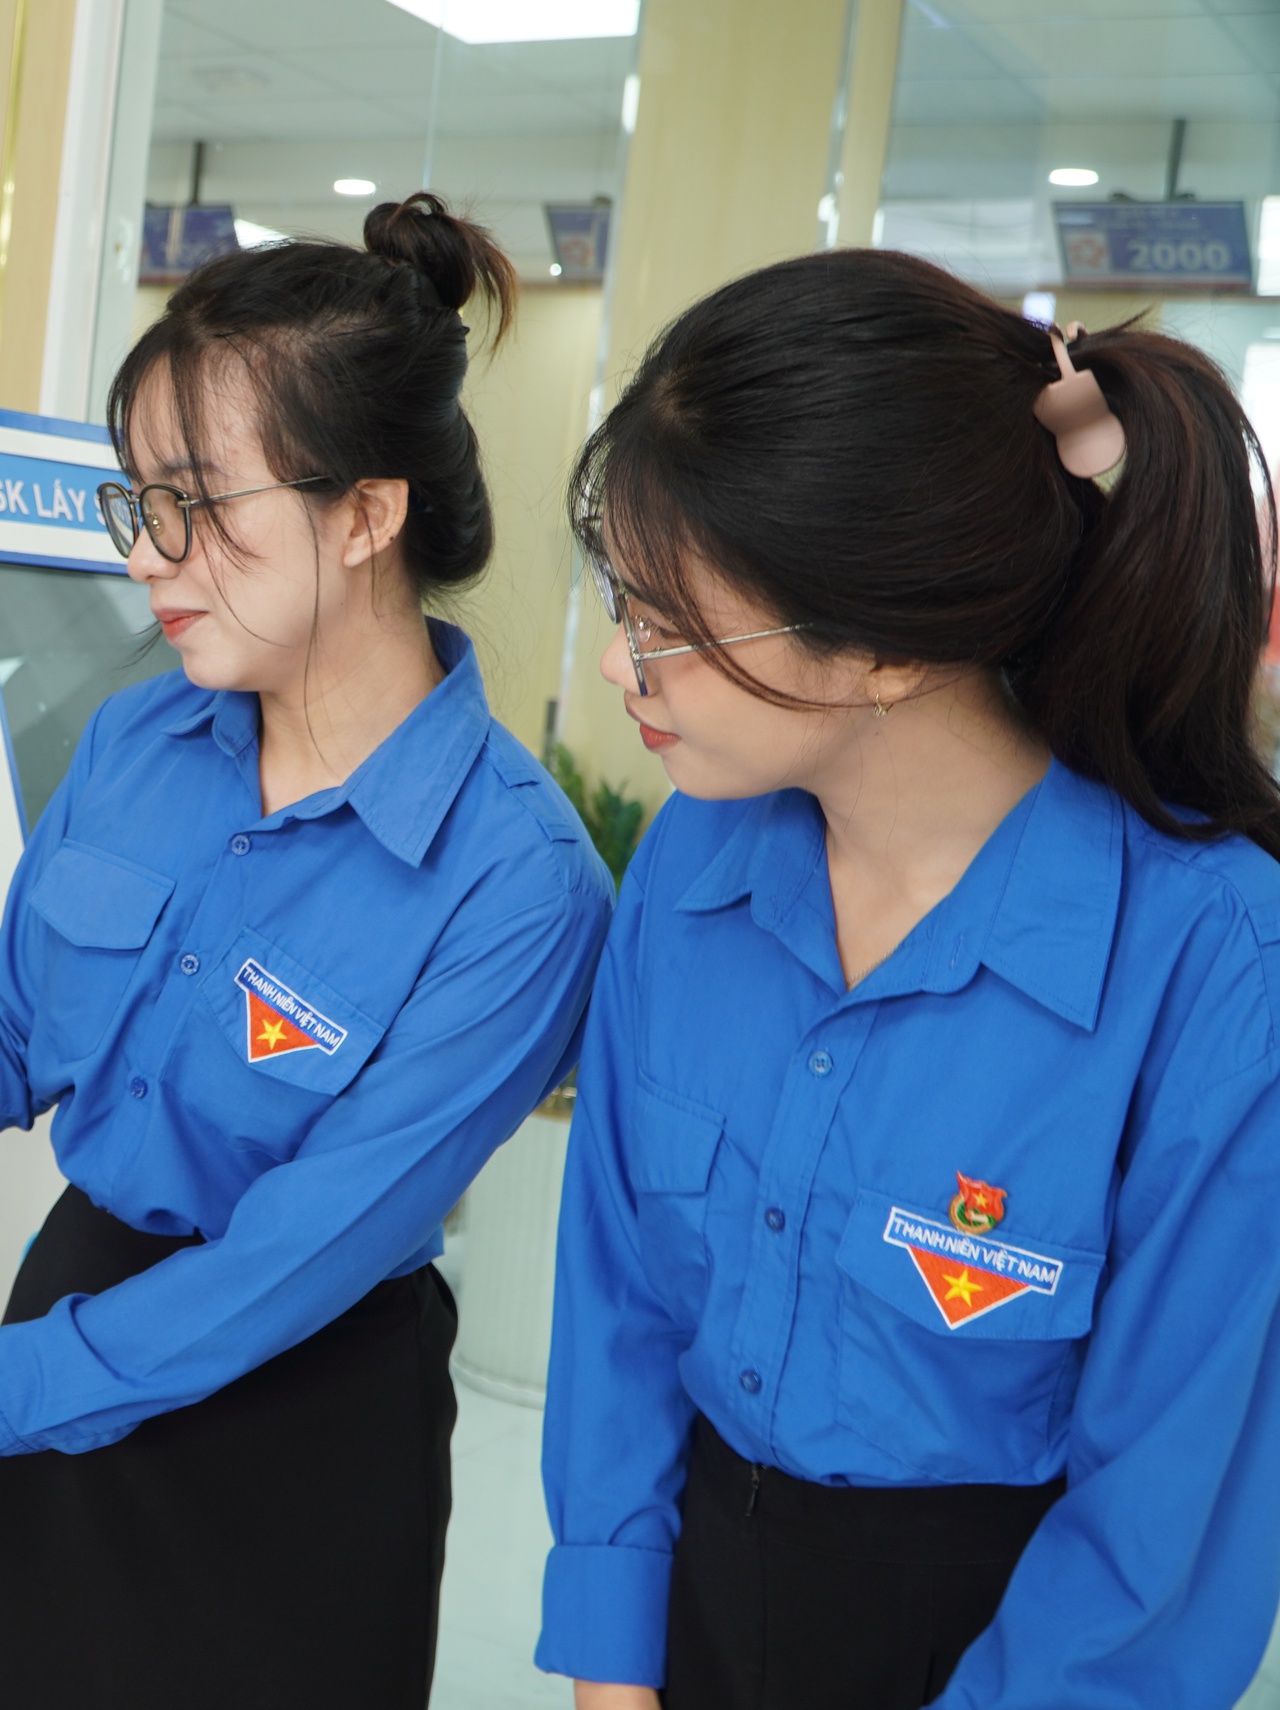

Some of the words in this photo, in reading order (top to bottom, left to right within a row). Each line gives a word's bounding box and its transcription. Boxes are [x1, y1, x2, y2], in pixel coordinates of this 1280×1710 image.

[1127, 240, 1231, 271] 2000
[243, 965, 278, 999] THANH
[272, 992, 298, 1015] NIÊN
[295, 1007, 317, 1029] VIỆT
[313, 1023, 341, 1047] NAM
[893, 1217, 947, 1249] THANH
[943, 1236, 980, 1262] NIÊN
[981, 1247, 1018, 1272] VIỆT
[1017, 1259, 1056, 1284] NAM
